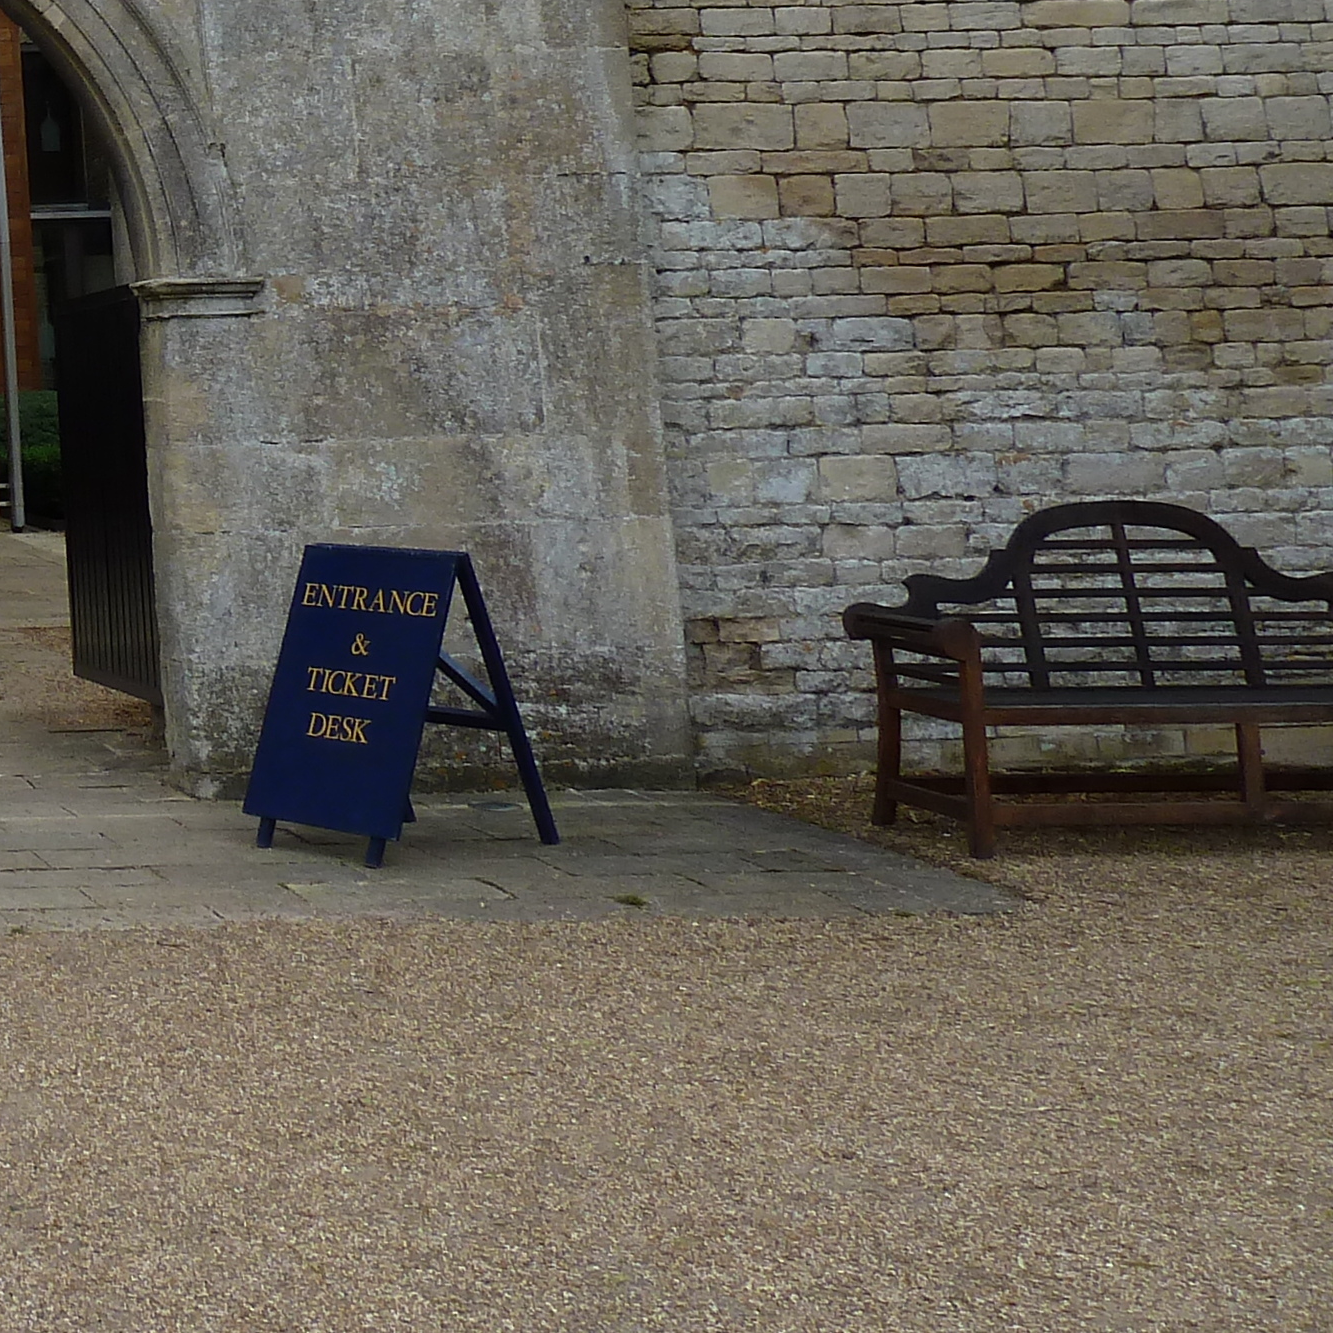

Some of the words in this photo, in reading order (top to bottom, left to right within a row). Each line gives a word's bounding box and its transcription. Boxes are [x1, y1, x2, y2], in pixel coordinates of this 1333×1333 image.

[301, 582, 439, 617] ENTRANCE
[351, 632, 371, 656] &
[306, 666, 397, 701] TICKET
[306, 712, 372, 744] DESK
